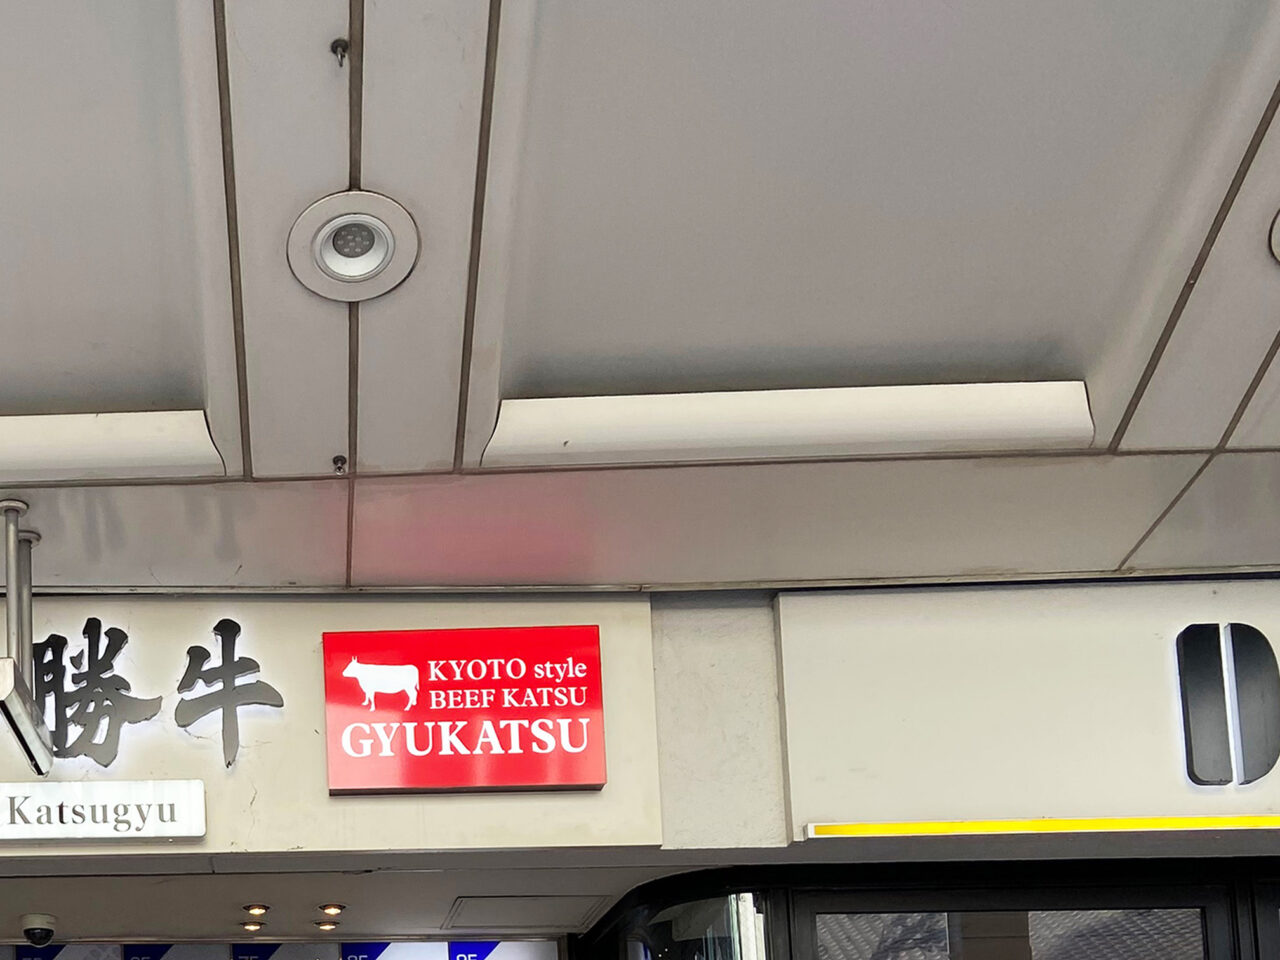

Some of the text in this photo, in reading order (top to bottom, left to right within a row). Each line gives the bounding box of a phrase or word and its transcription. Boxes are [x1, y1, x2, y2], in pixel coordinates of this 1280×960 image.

[428, 657, 587, 683] KYOTO style
[429, 687, 587, 709] BEEF KATSU
[341, 718, 590, 758] GYUKATSU
[7, 795, 178, 831] Katsugyu
